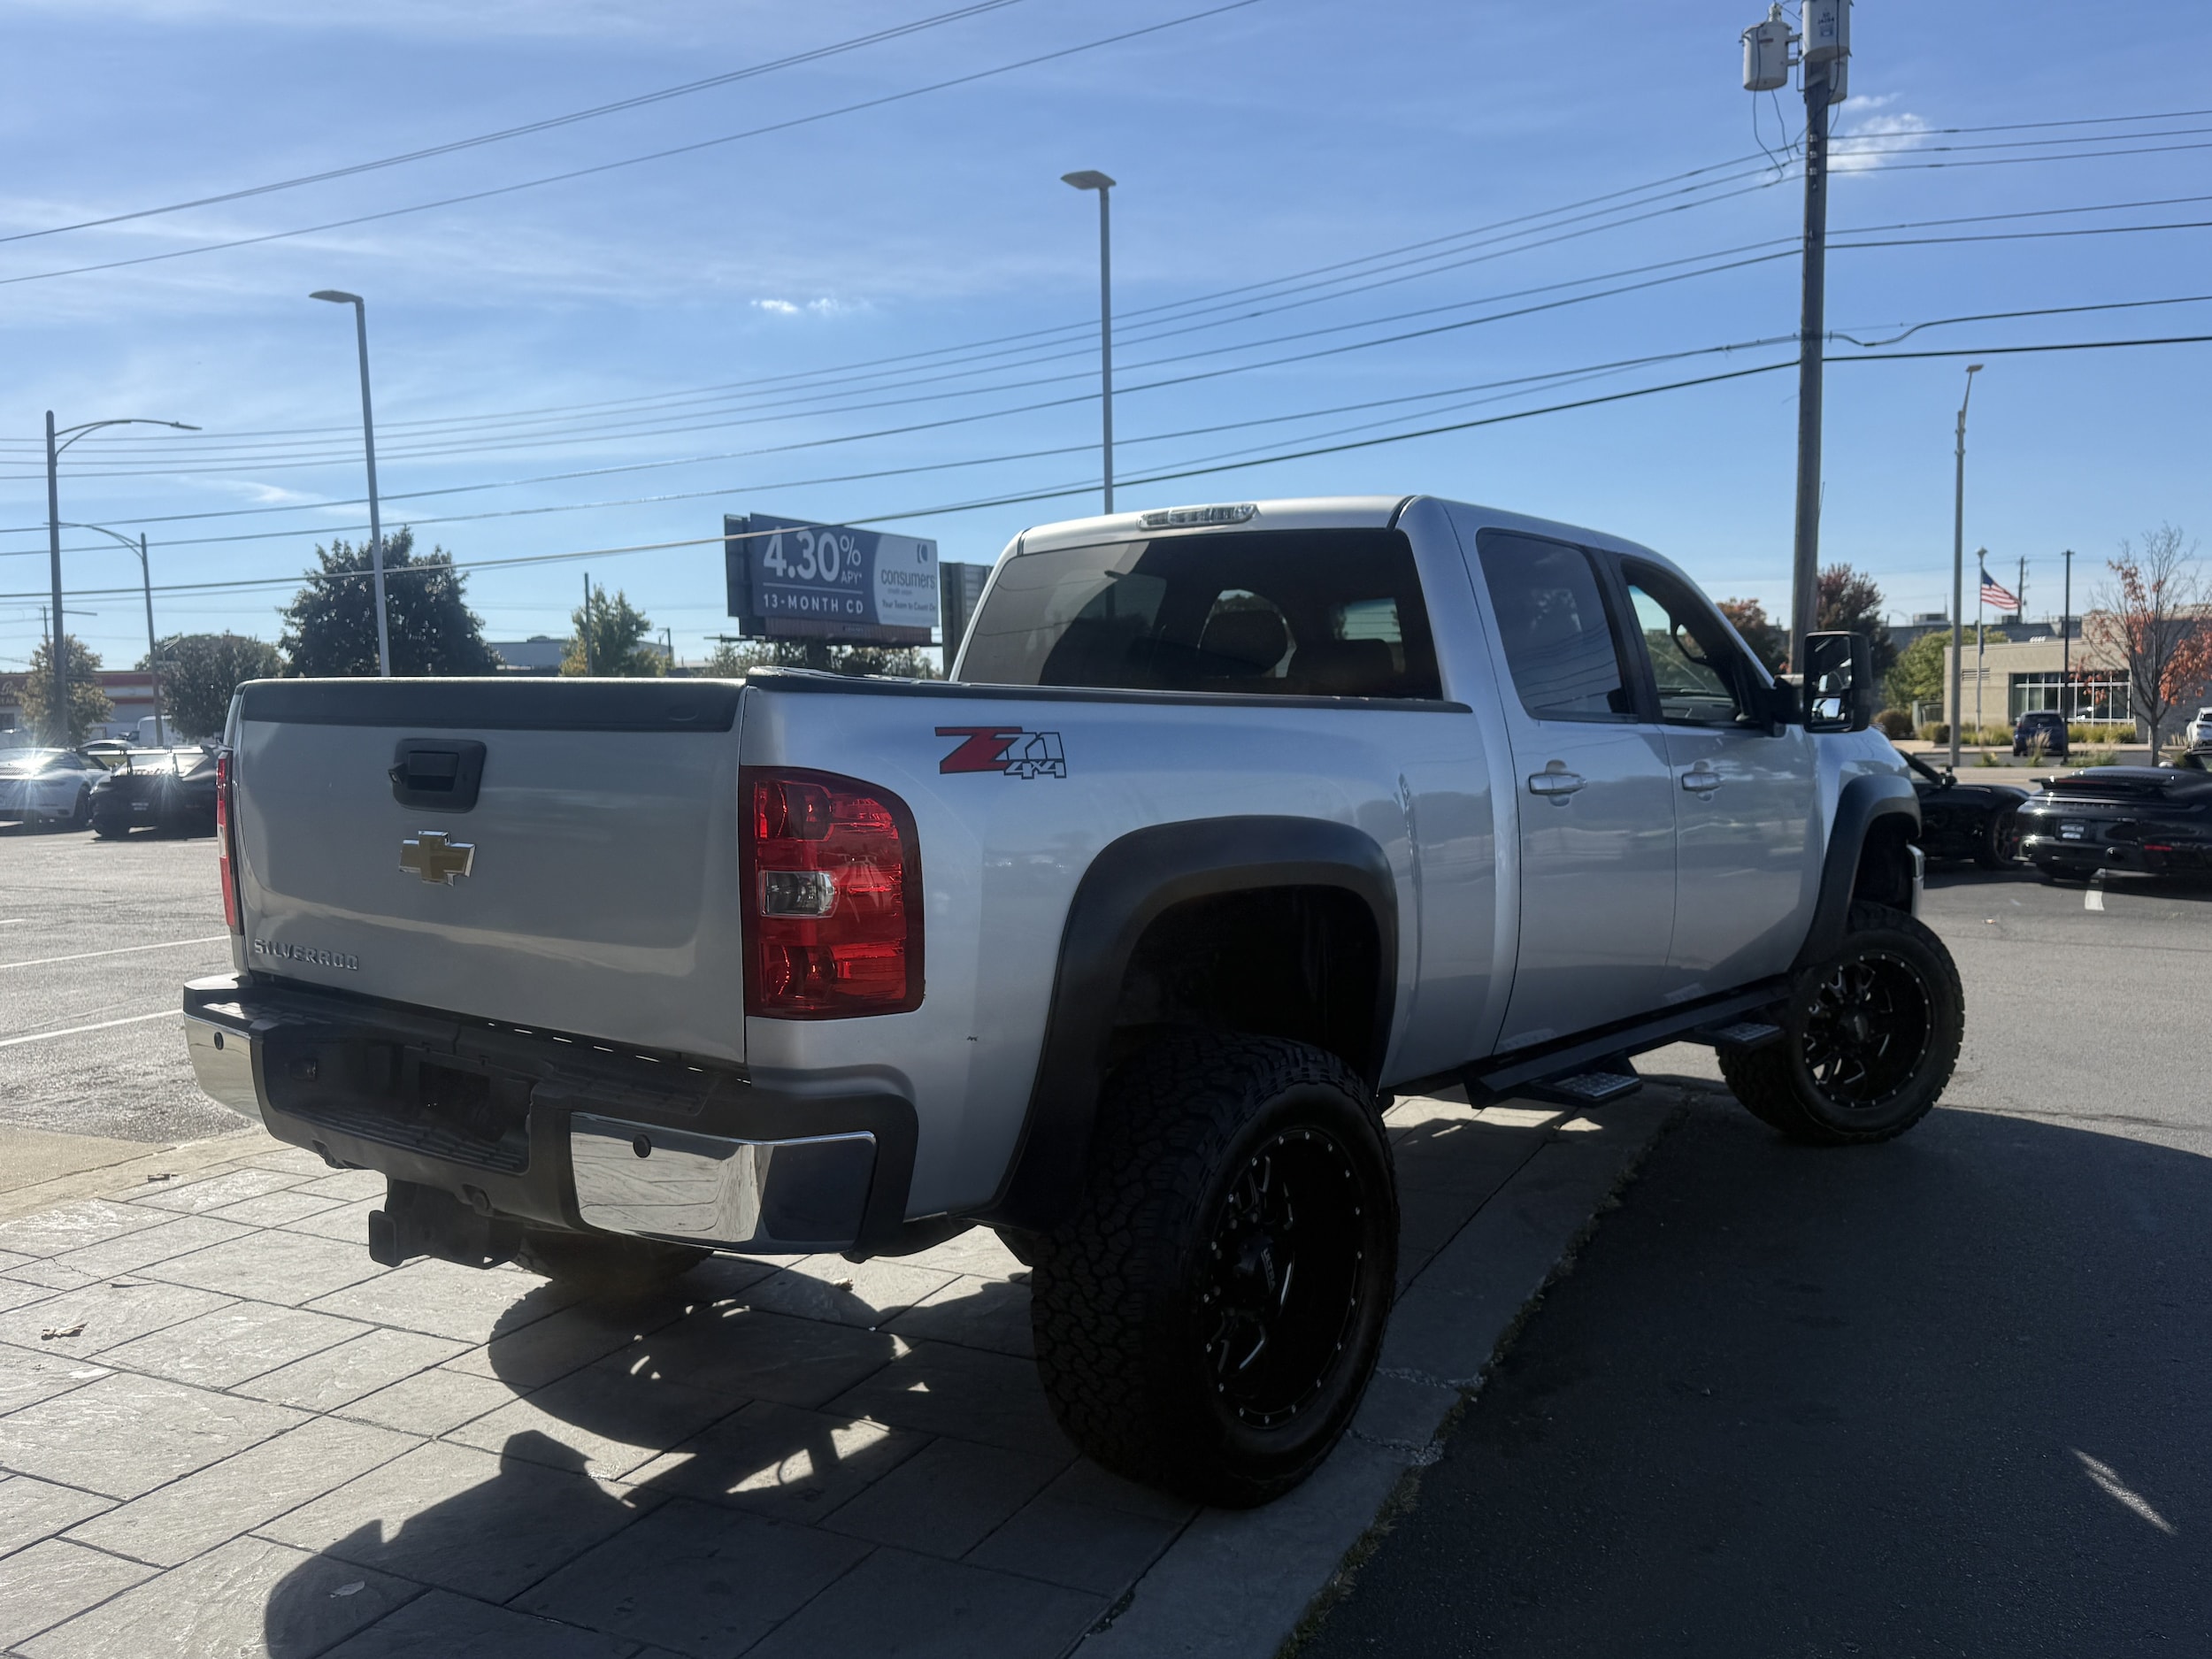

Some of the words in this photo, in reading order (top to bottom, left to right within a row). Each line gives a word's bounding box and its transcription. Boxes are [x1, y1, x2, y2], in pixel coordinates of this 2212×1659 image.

[880, 569, 936, 589] consumers
[764, 593, 839, 612] 13-MONTH
[846, 599, 864, 614] CD
[934, 726, 1064, 775] Z71
[254, 938, 359, 971] SILVERADO
